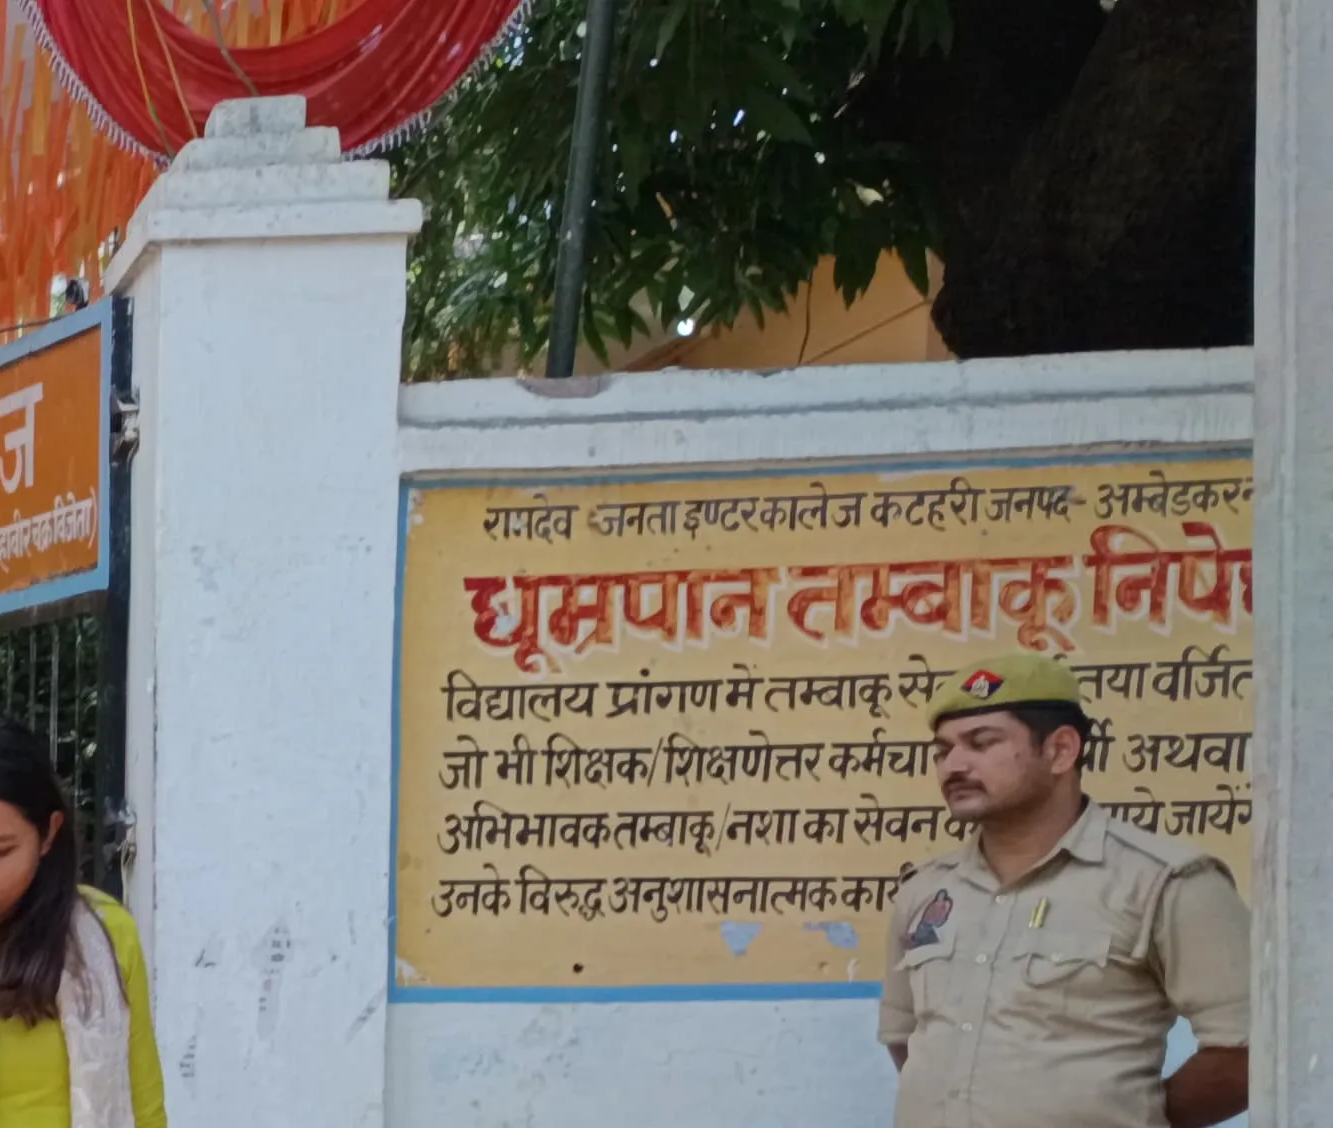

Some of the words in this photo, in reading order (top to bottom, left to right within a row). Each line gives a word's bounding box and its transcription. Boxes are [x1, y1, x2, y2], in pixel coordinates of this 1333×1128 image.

[483, 494, 578, 544] रामदेव
[595, 500, 683, 537] जनता
[682, 497, 760, 539] इण्टर
[761, 482, 867, 531] कालेज
[870, 477, 985, 531] कटहरी
[1094, 470, 1253, 519] अम्बेडकर
[787, 555, 1075, 652] तम्बाकू
[440, 669, 599, 722] विद्यालय
[605, 668, 723, 718] प्रांगण
[726, 663, 764, 711] में
[764, 673, 893, 719] तम्बाकू
[439, 734, 488, 789] जो
[494, 733, 537, 785] भी
[828, 727, 935, 779] कर्मचा
[1123, 732, 1253, 773] अथवा
[437, 800, 610, 854] अभिभावक
[803, 808, 850, 844] का
[854, 793, 946, 845] सेवन
[431, 863, 511, 917] उनके
[514, 864, 607, 922] विरुद्ध
[608, 876, 837, 923] अनुशासनात्मक
